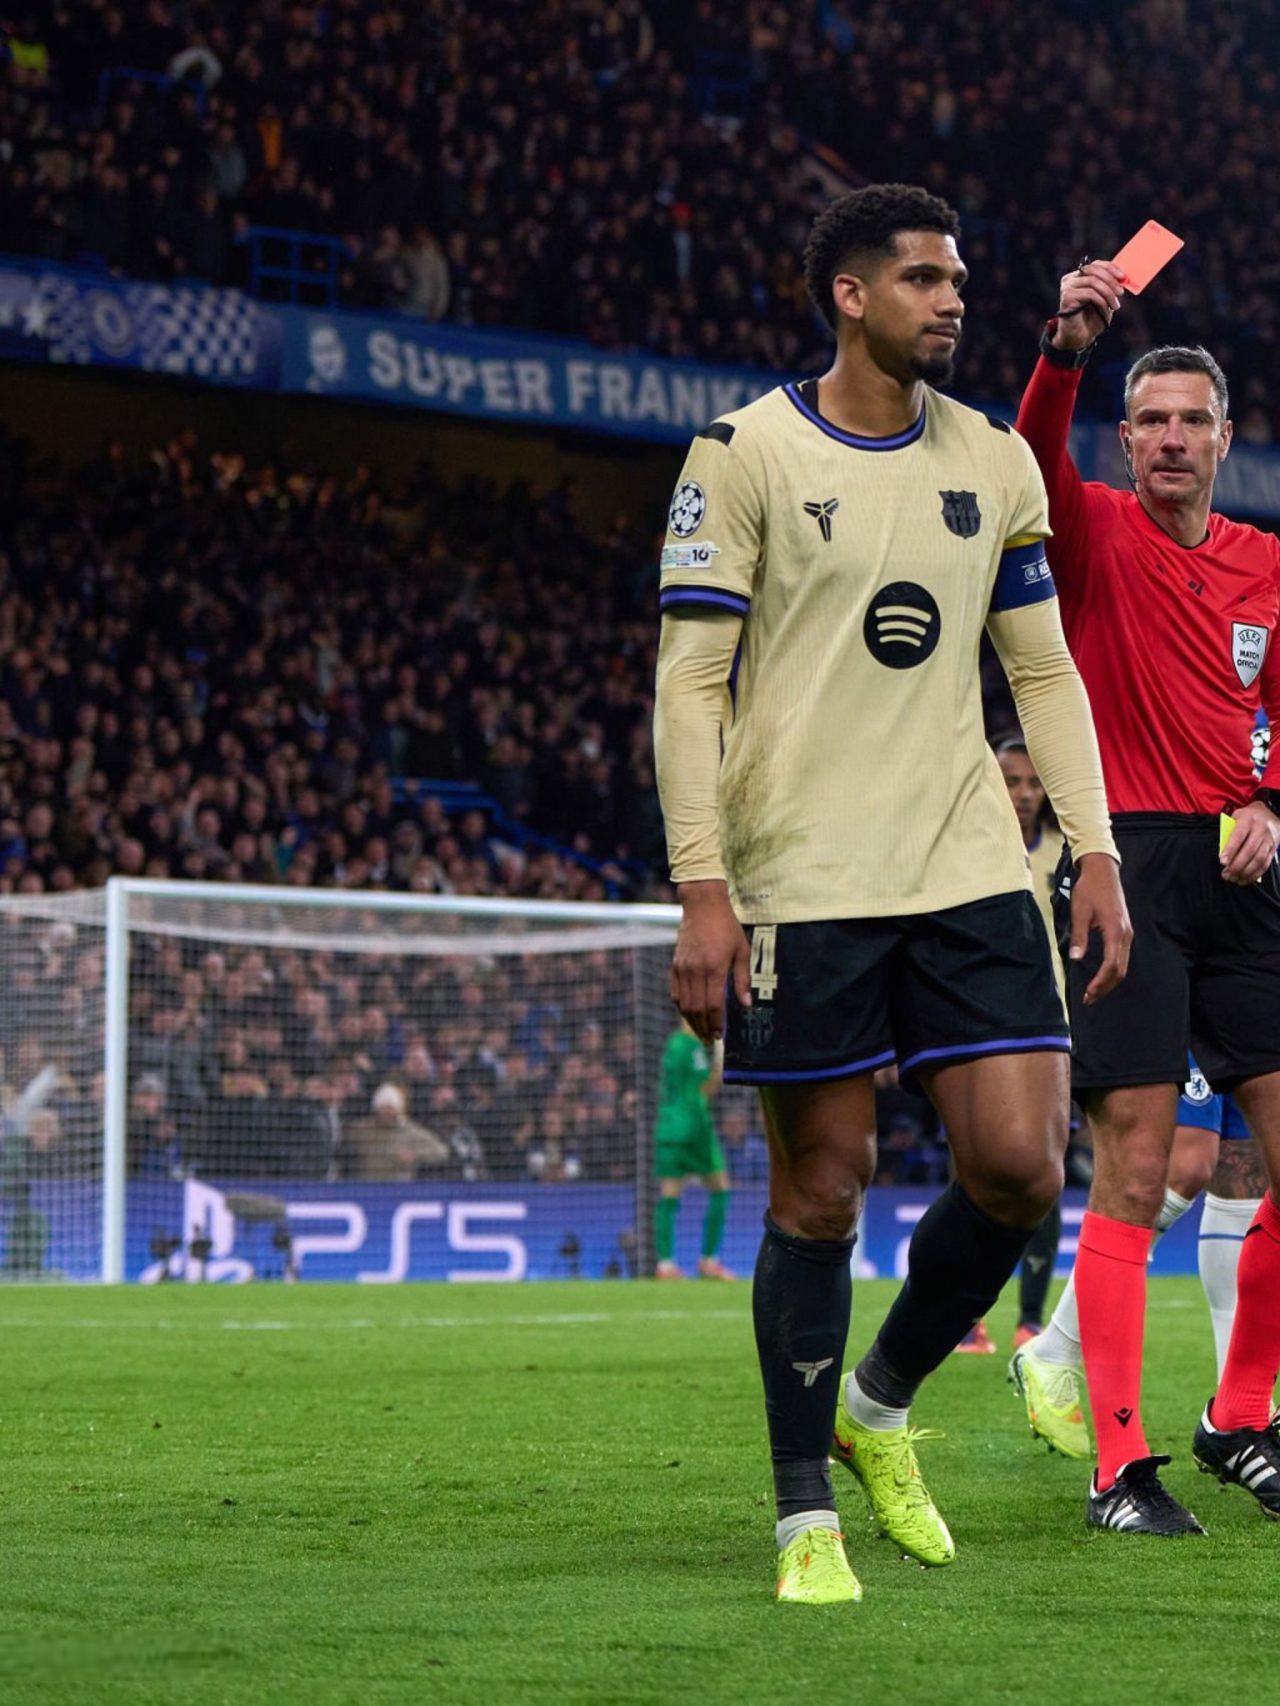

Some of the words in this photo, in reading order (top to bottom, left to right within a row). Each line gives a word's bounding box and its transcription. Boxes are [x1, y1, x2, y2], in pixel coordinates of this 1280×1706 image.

[367, 329, 555, 415] SUPER
[1239, 630, 1262, 646] UEFA
[1239, 649, 1260, 660] MATCH
[751, 924, 778, 1000] 4
[285, 1201, 528, 1283] PS5
